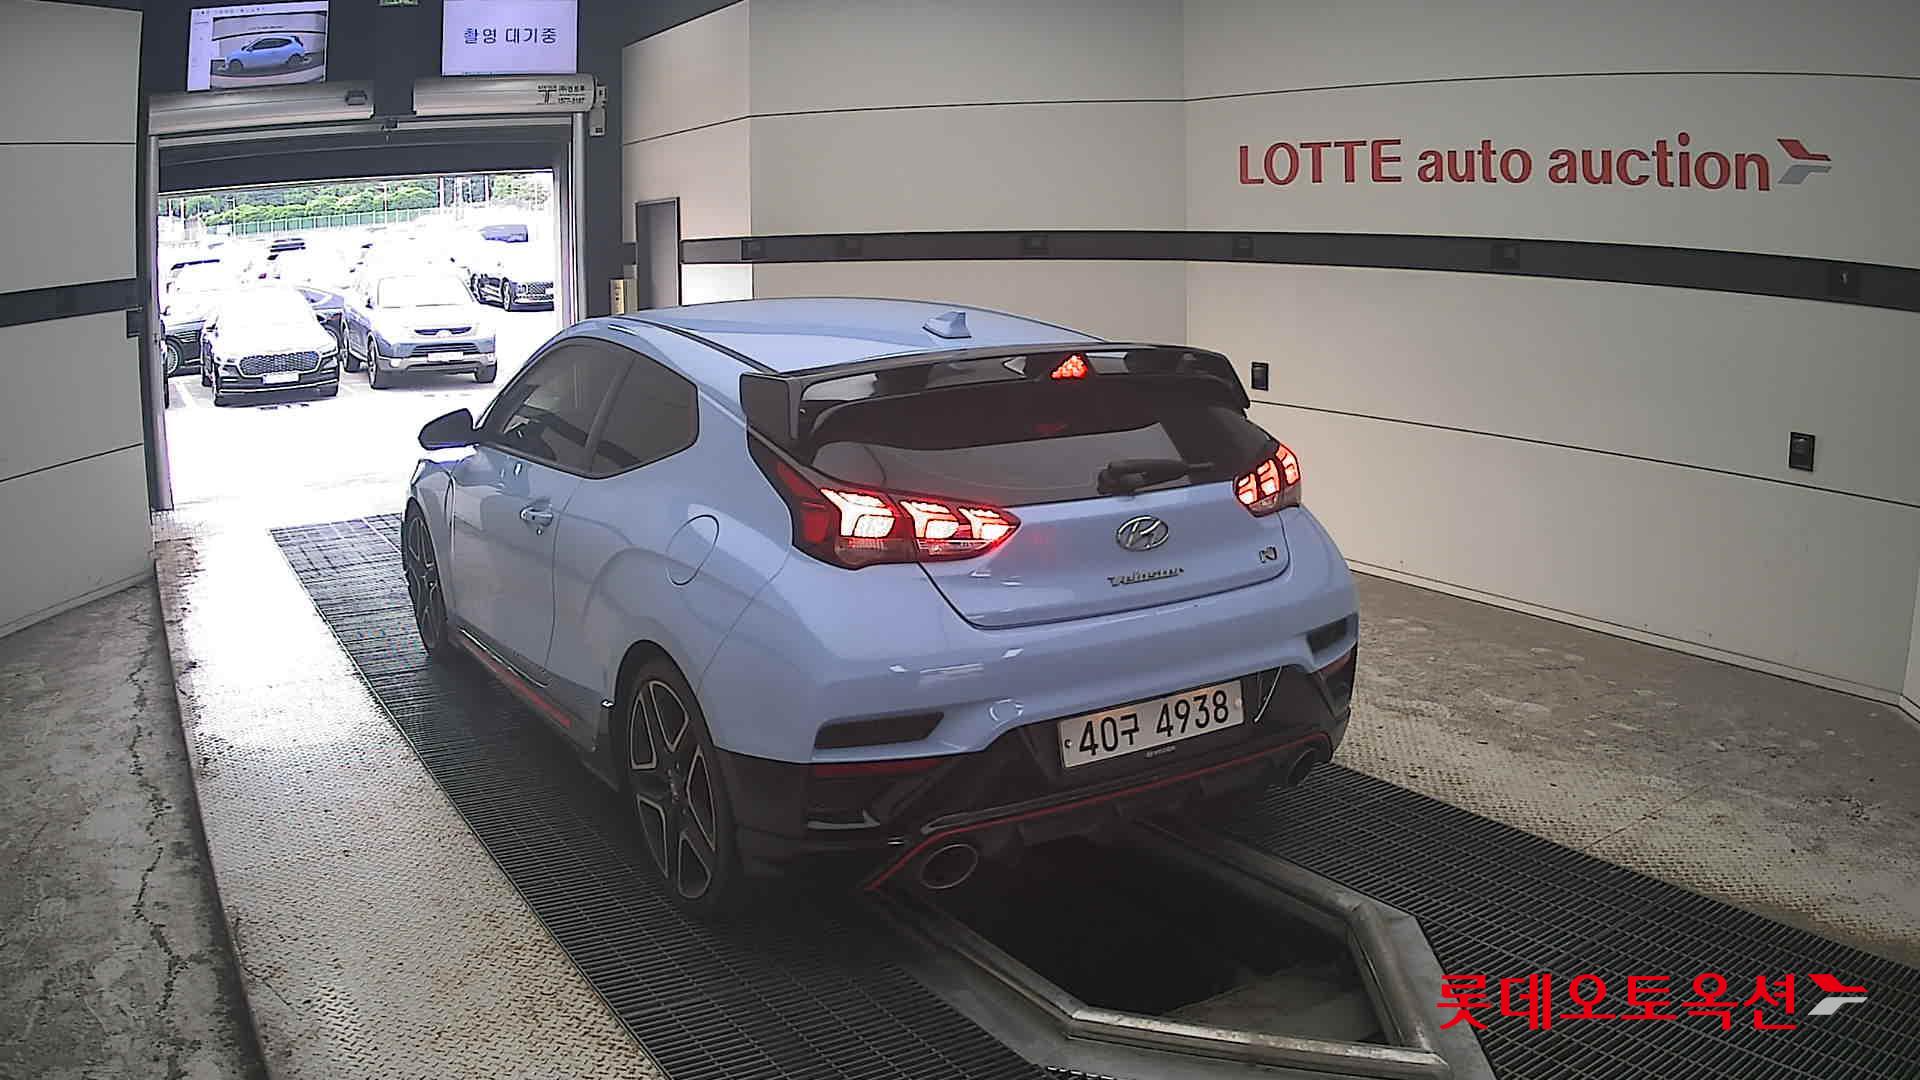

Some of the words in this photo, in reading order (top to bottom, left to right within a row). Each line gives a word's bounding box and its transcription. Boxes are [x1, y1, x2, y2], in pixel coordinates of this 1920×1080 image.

[464, 28, 497, 44] 촬영
[505, 28, 557, 44] 대기중
[1239, 139, 1402, 185] LOTTE
[1417, 139, 1532, 184] auto
[1548, 131, 1771, 191] auction
[1079, 712, 1140, 756] 40구
[1156, 690, 1230, 737] 4938
